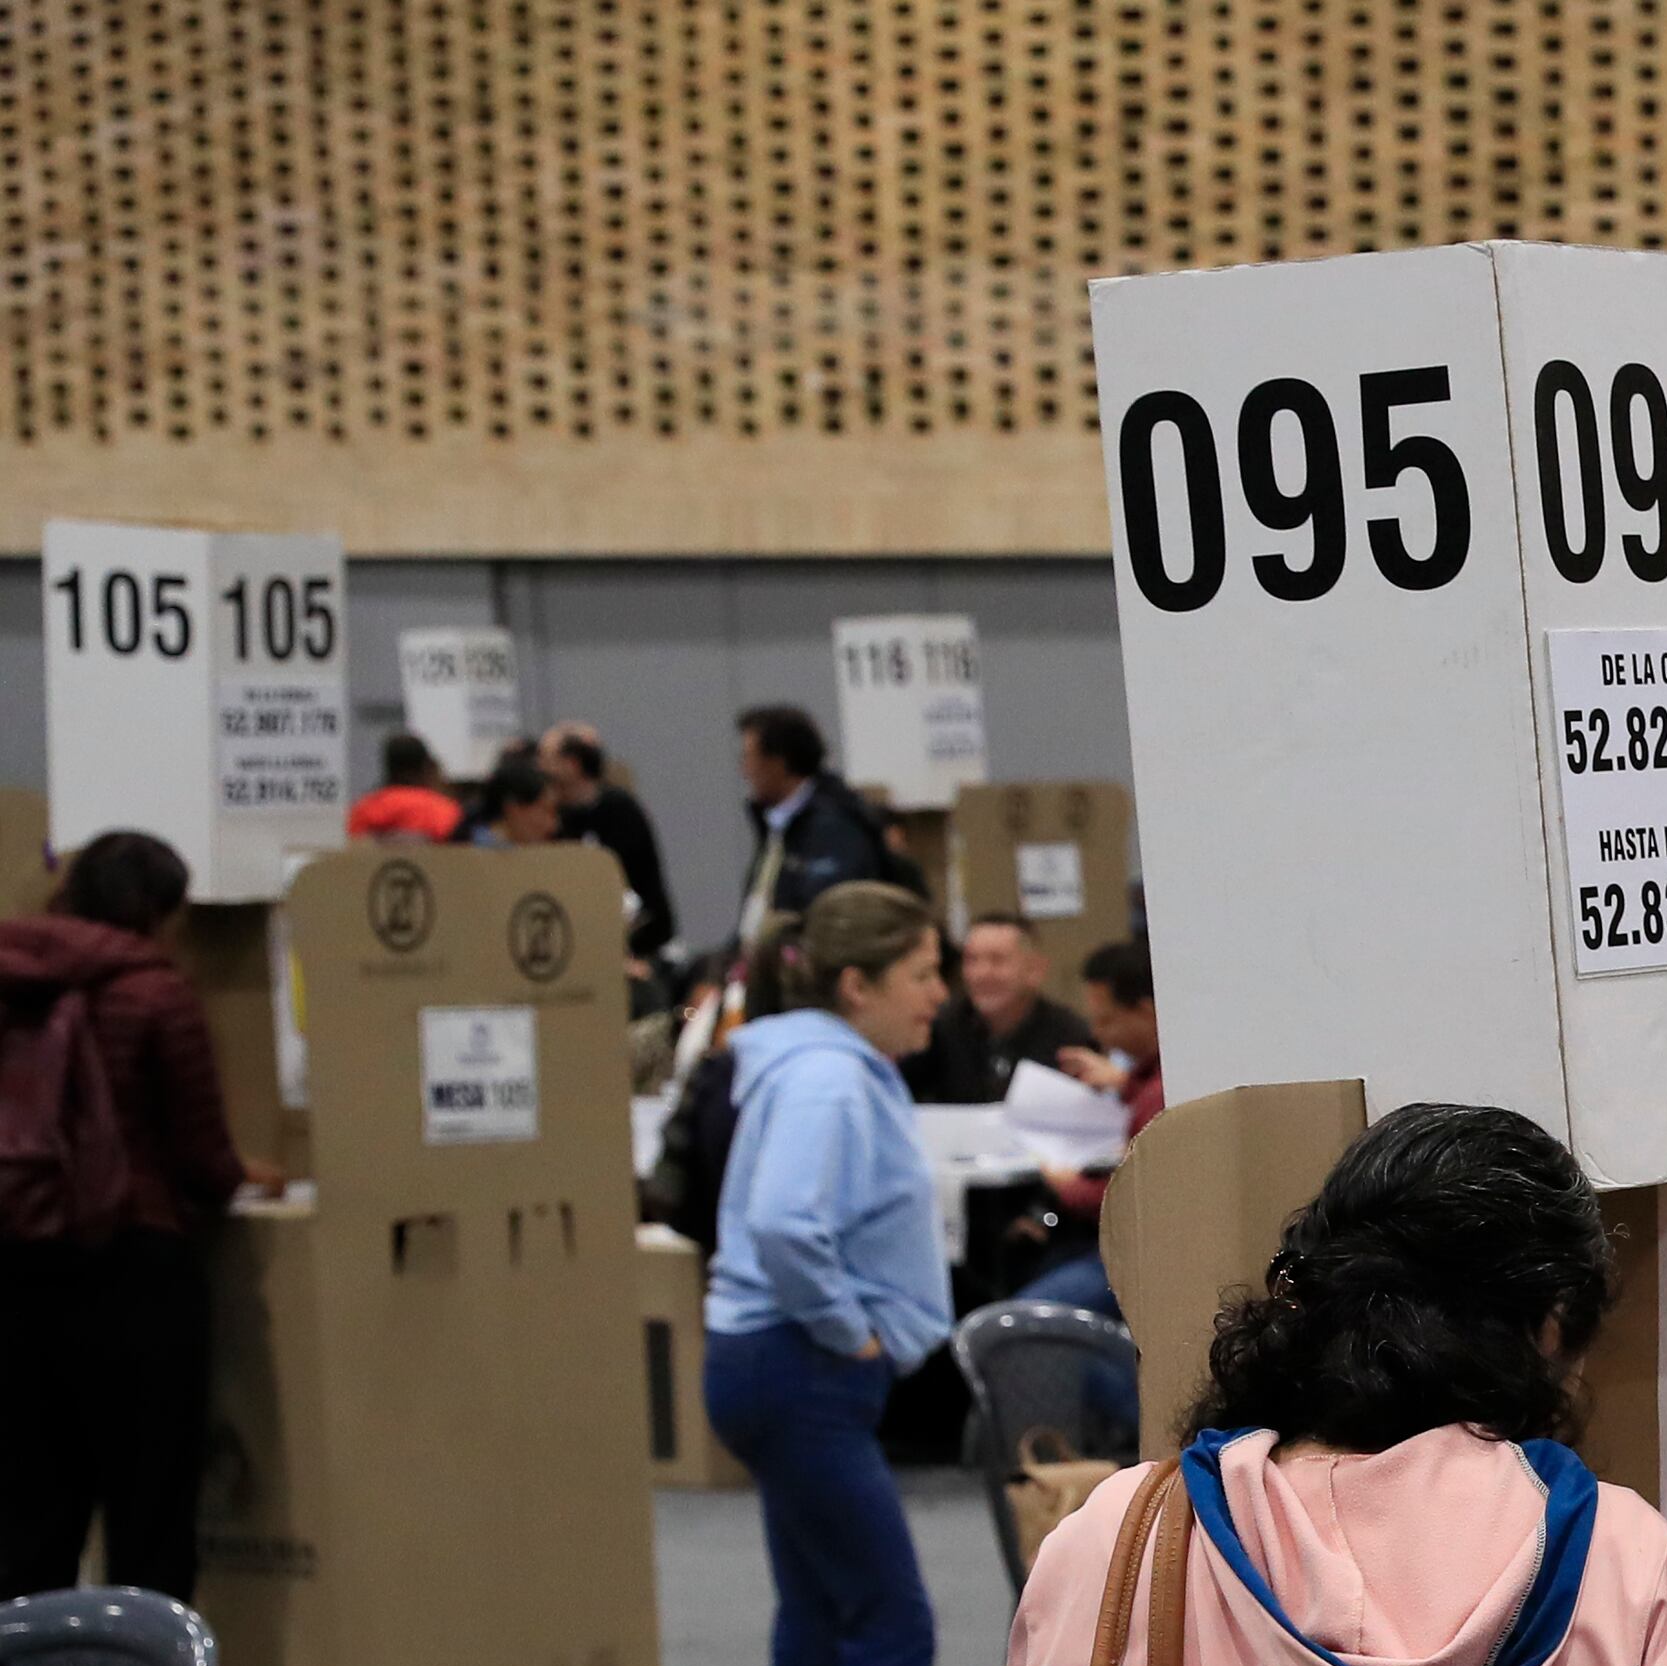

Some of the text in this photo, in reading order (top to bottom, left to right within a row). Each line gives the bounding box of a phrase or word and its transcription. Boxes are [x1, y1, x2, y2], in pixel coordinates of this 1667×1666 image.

[1119, 365, 1471, 612] 095
[55, 567, 191, 658] 105
[225, 578, 334, 662] 105
[1602, 654, 1626, 685] DE
[1632, 653, 1656, 684] LA
[1599, 827, 1660, 862] HASTA
